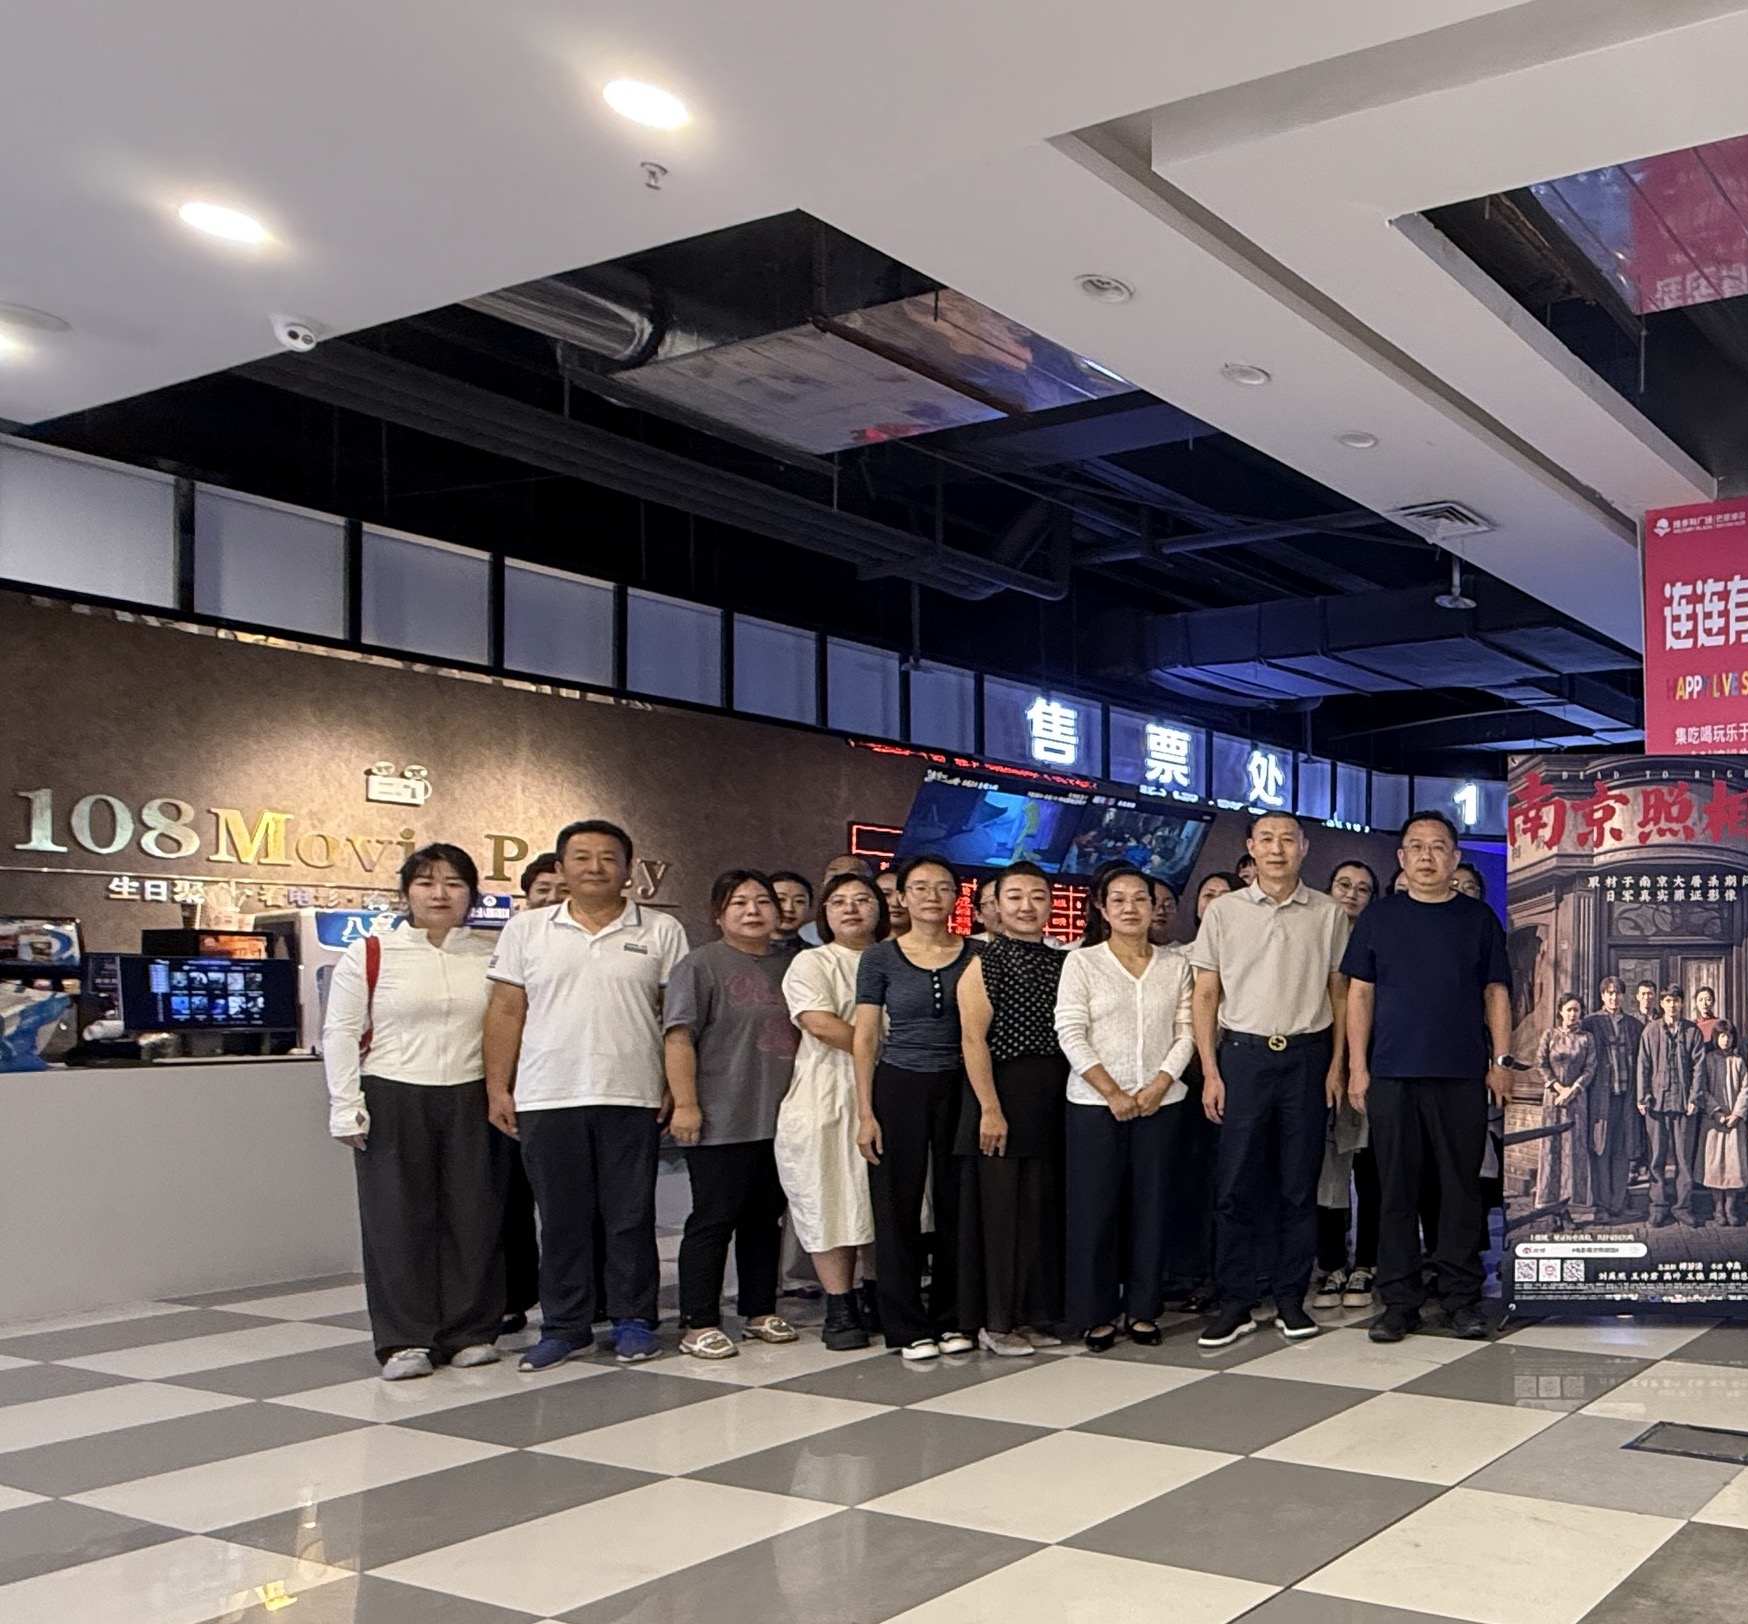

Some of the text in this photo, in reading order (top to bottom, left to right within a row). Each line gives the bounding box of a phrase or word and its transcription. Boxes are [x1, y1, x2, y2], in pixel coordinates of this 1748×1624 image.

[1667, 675, 1709, 700] HAPPY
[1712, 672, 1739, 698] LVE
[1026, 696, 1284, 806] 售票处
[1562, 770, 1621, 780] DEAD
[1645, 770, 1669, 779] TO
[1453, 784, 1478, 825] 1
[1604, 889, 1738, 902] 日军真实罪证影像
